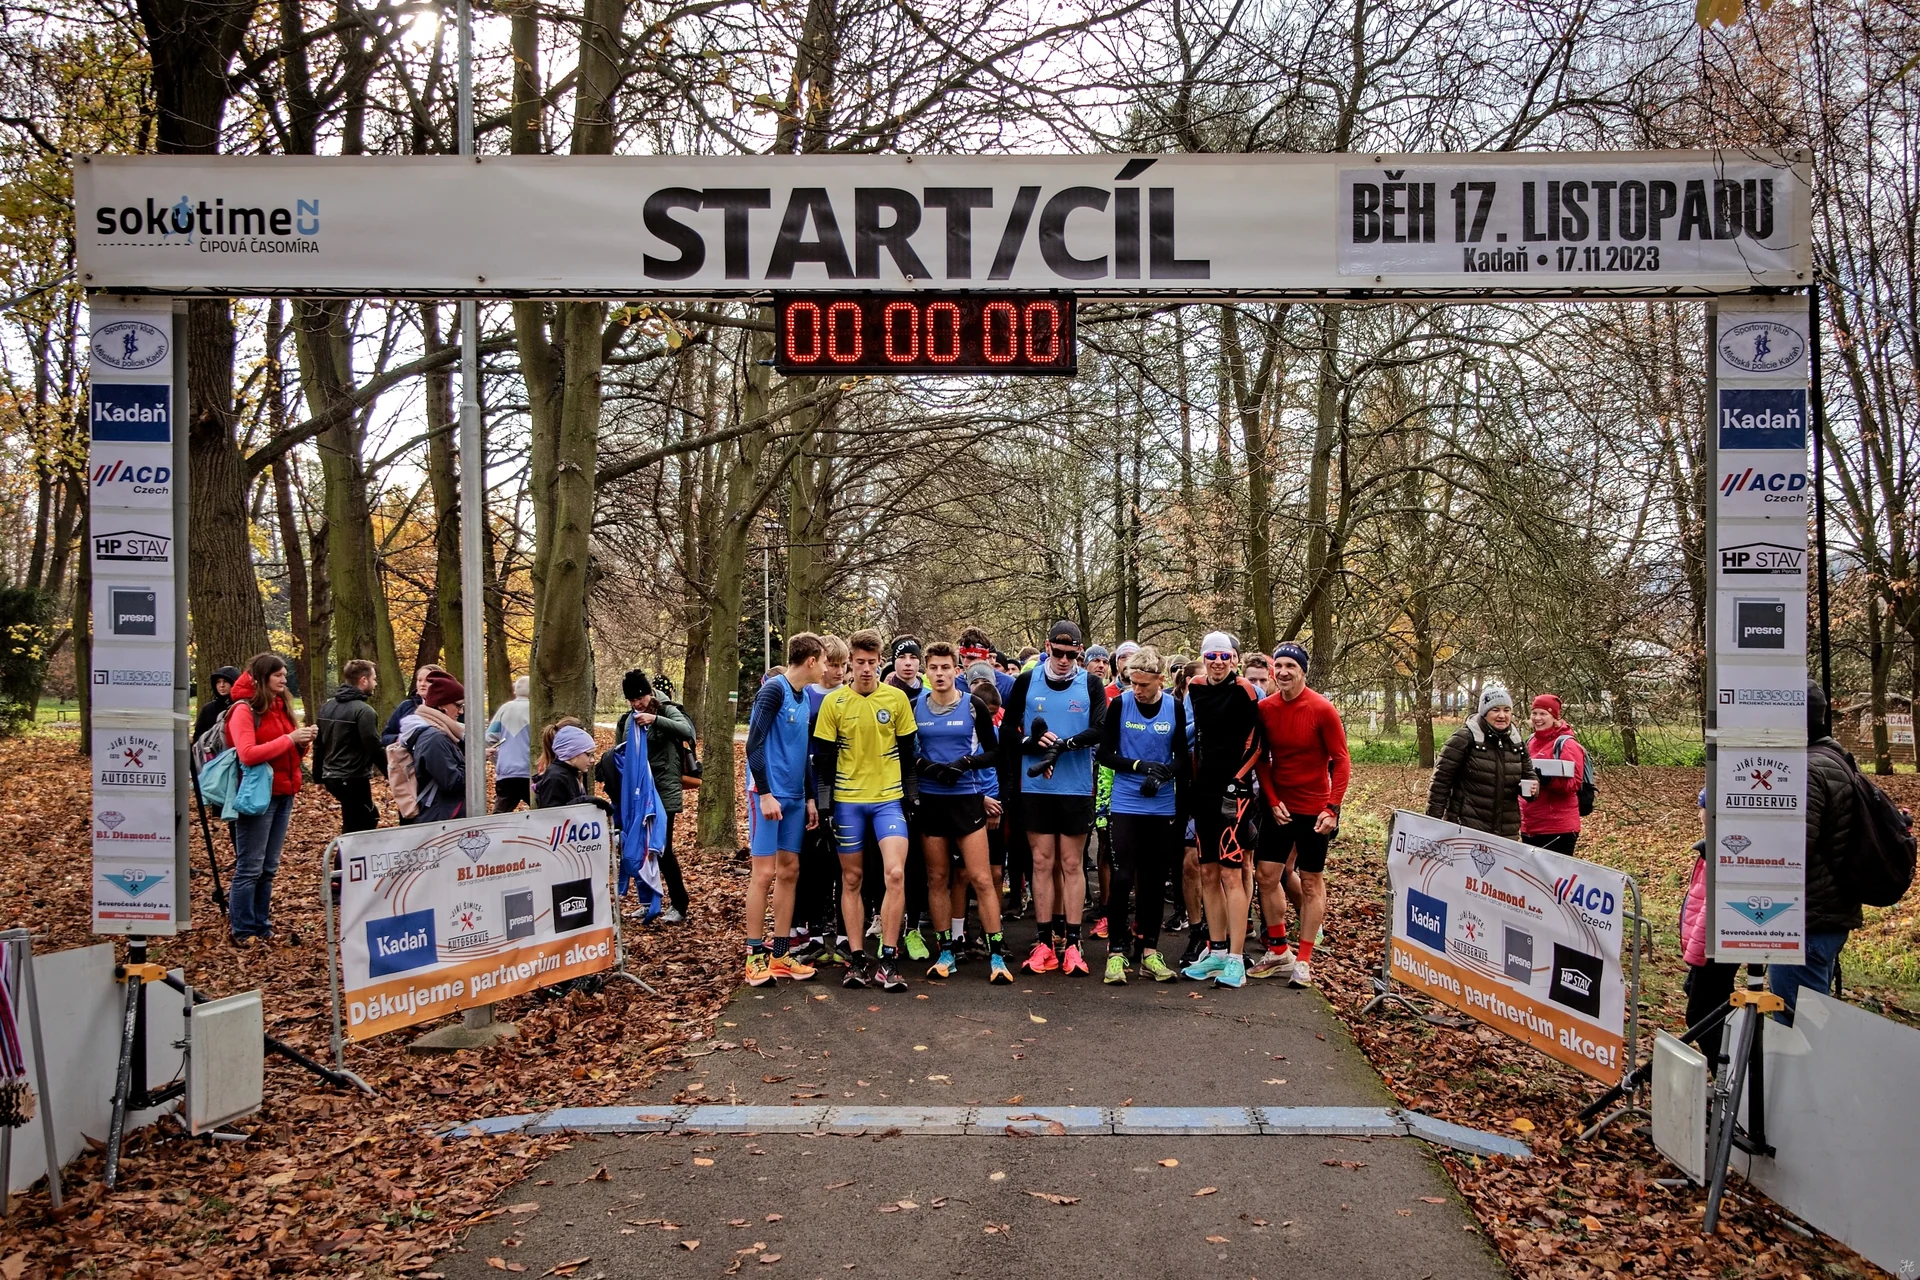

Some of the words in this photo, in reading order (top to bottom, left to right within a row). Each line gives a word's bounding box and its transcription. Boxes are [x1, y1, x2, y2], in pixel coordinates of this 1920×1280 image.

[1352, 169, 1436, 244] BĚH
[1450, 181, 1507, 244] 17.
[1522, 178, 1774, 242] LISTOPADU
[96, 197, 292, 236] sokotime
[643, 158, 1211, 281] START/CÍL
[199, 237, 248, 254] ČIPOVÁ
[250, 237, 320, 254] ČASOMÍRA
[1463, 245, 1529, 273] Kadaň
[1556, 246, 1660, 273] 17.11.2023
[139, 324, 155, 336] klub
[1733, 323, 1772, 337] Sportovní
[1773, 325, 1790, 337] klub
[1752, 361, 1778, 371] policie
[94, 402, 167, 423] Kadaň
[1722, 408, 1801, 429] Kadaň
[118, 466, 171, 484] ACD
[1748, 473, 1807, 492] ACD
[133, 485, 169, 495] Czech
[1764, 493, 1804, 503] Czech
[96, 539, 122, 554] HP
[127, 540, 169, 555] STAV
[1722, 552, 1750, 567] HP
[1756, 551, 1801, 568] STAV
[119, 613, 154, 625] presne
[1744, 625, 1783, 637] presne
[112, 669, 172, 683] MESSOR
[1738, 689, 1805, 702] MESSOR
[1125, 720, 1146, 731] Sweep
[101, 773, 167, 785] AUTOSERVIS
[1725, 796, 1797, 808] AUTOSERVIS
[112, 831, 157, 840] Diamond
[566, 820, 601, 844] ACD
[576, 843, 602, 854] Czech
[370, 846, 440, 872] MESSOR
[1719, 855, 1734, 864] BL
[1736, 856, 1786, 866] Diamond
[122, 868, 146, 882] SD
[457, 866, 474, 881] BL
[476, 857, 526, 878] Diamond
[1465, 876, 1479, 892] BL
[1481, 881, 1526, 909] Diamond
[1570, 883, 1614, 916] ACD
[97, 900, 141, 908] Severočeské
[143, 901, 157, 909] doly
[560, 902, 571, 913] HP
[571, 899, 586, 911] STAV
[1747, 895, 1774, 910] SD
[509, 914, 534, 930] presne
[1410, 904, 1441, 934] Kadaň
[1580, 912, 1613, 932] Czech
[448, 932, 490, 950] AUTOSERVIS
[1720, 929, 1768, 937] Severočeské
[1769, 930, 1785, 938] doly
[376, 929, 428, 958] Kadaň
[1453, 940, 1488, 961] AUTOSERVIS
[1508, 953, 1531, 969] presne
[349, 977, 466, 1026] Děkujeme
[470, 950, 561, 993] partnerům
[564, 937, 611, 966] akce!
[1560, 970, 1574, 983] HP
[1573, 975, 1591, 991] STAV
[1392, 946, 1462, 996] Děkujeme
[1465, 984, 1555, 1041] partnerům
[1559, 1027, 1616, 1069] akce!
